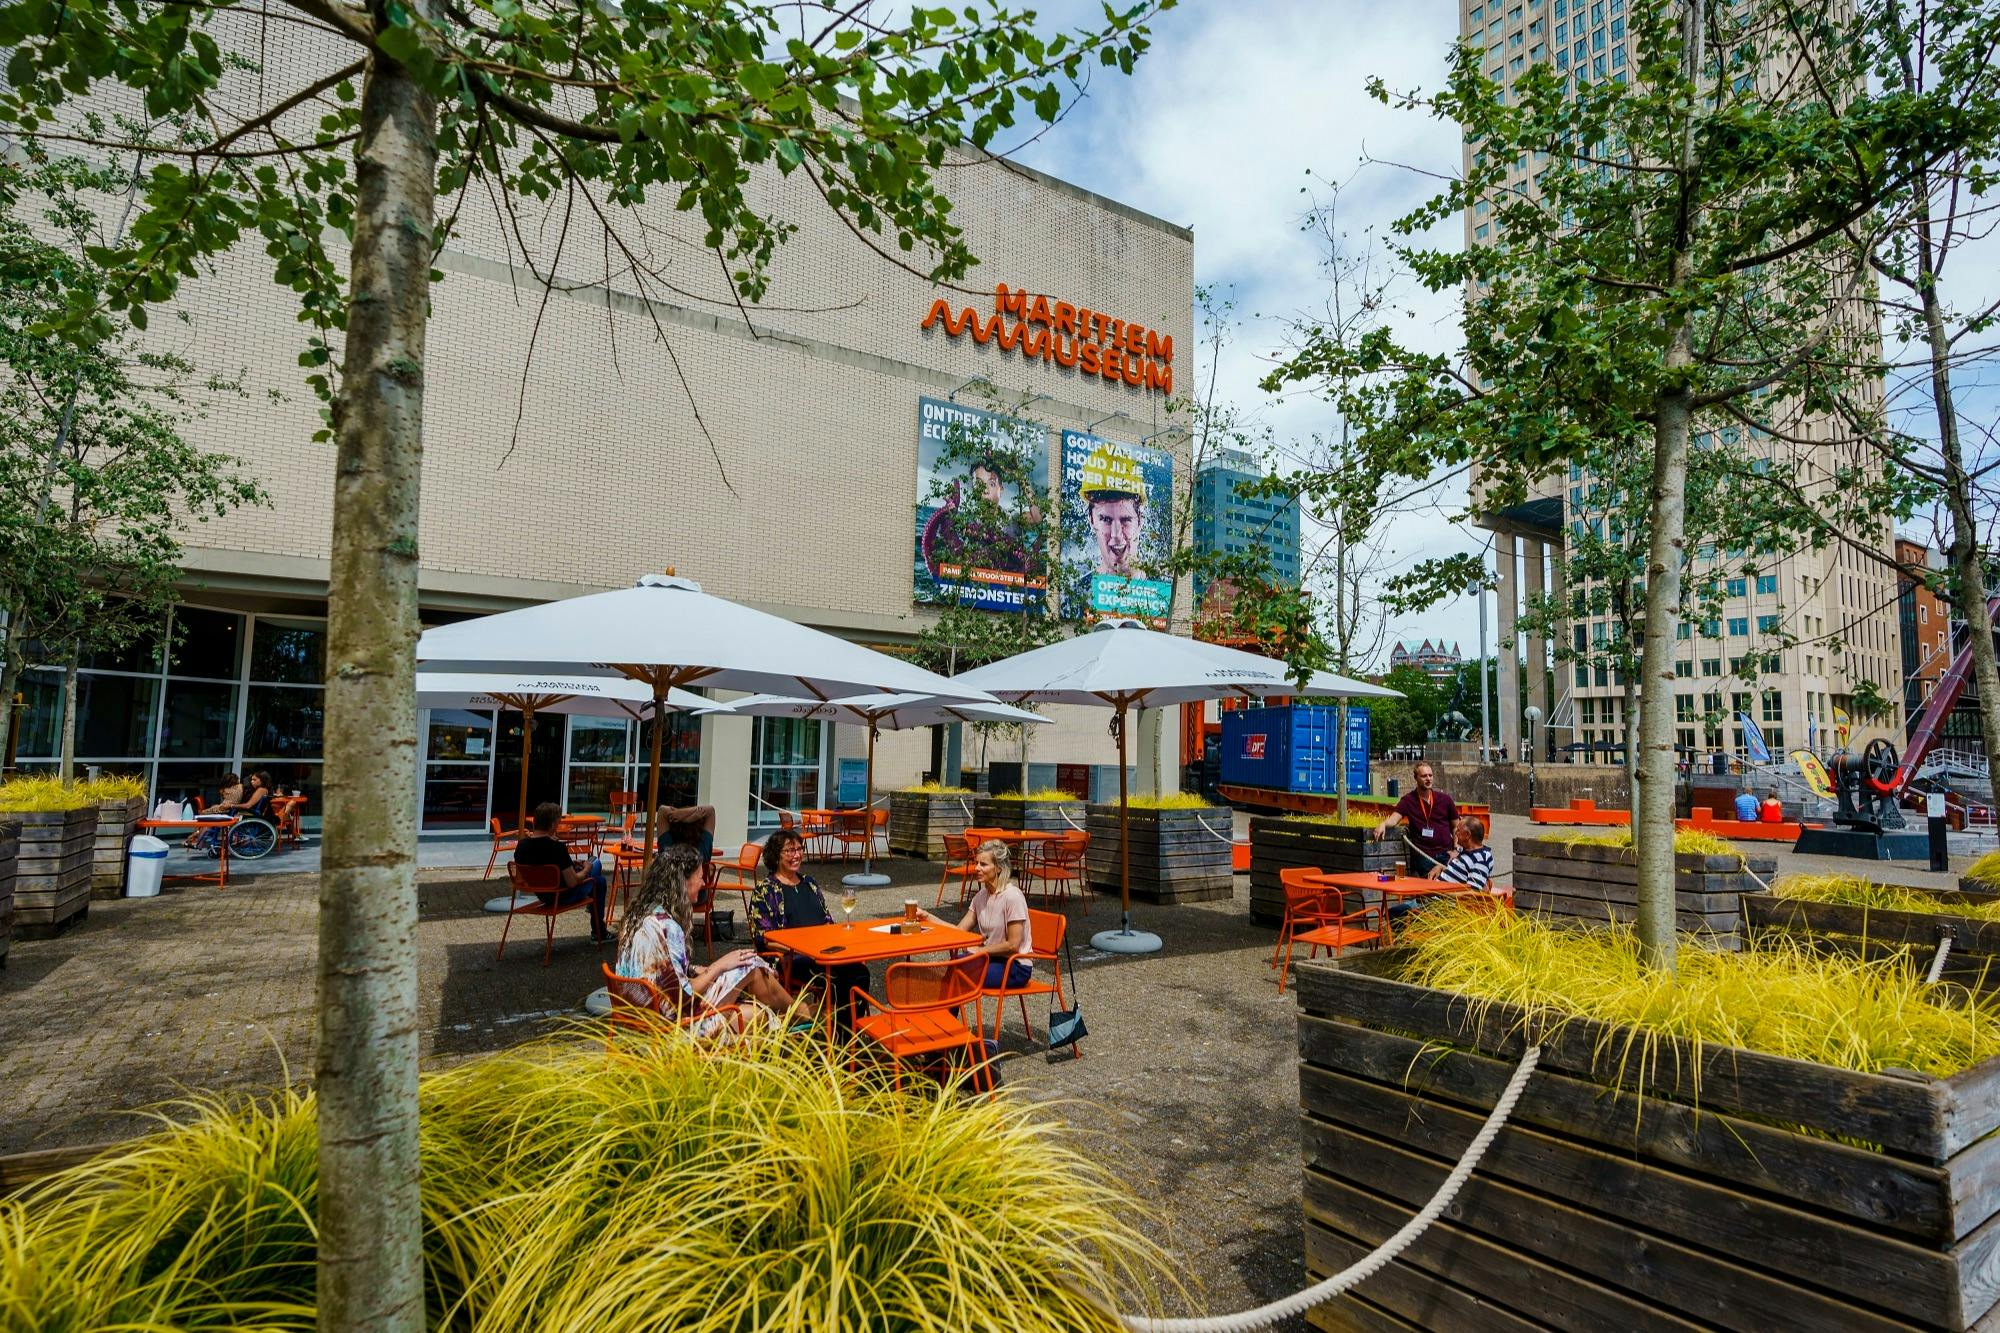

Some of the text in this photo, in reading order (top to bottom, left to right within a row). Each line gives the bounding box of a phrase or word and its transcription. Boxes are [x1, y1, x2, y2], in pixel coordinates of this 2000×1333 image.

[995, 282, 1173, 363] MARITIEM
[1067, 435, 1102, 453] GOLF
[1105, 444, 1132, 459] VAN
[1067, 451, 1107, 470] HOUD
[1110, 461, 1127, 474] JIJ
[1067, 467, 1102, 486] ROER
